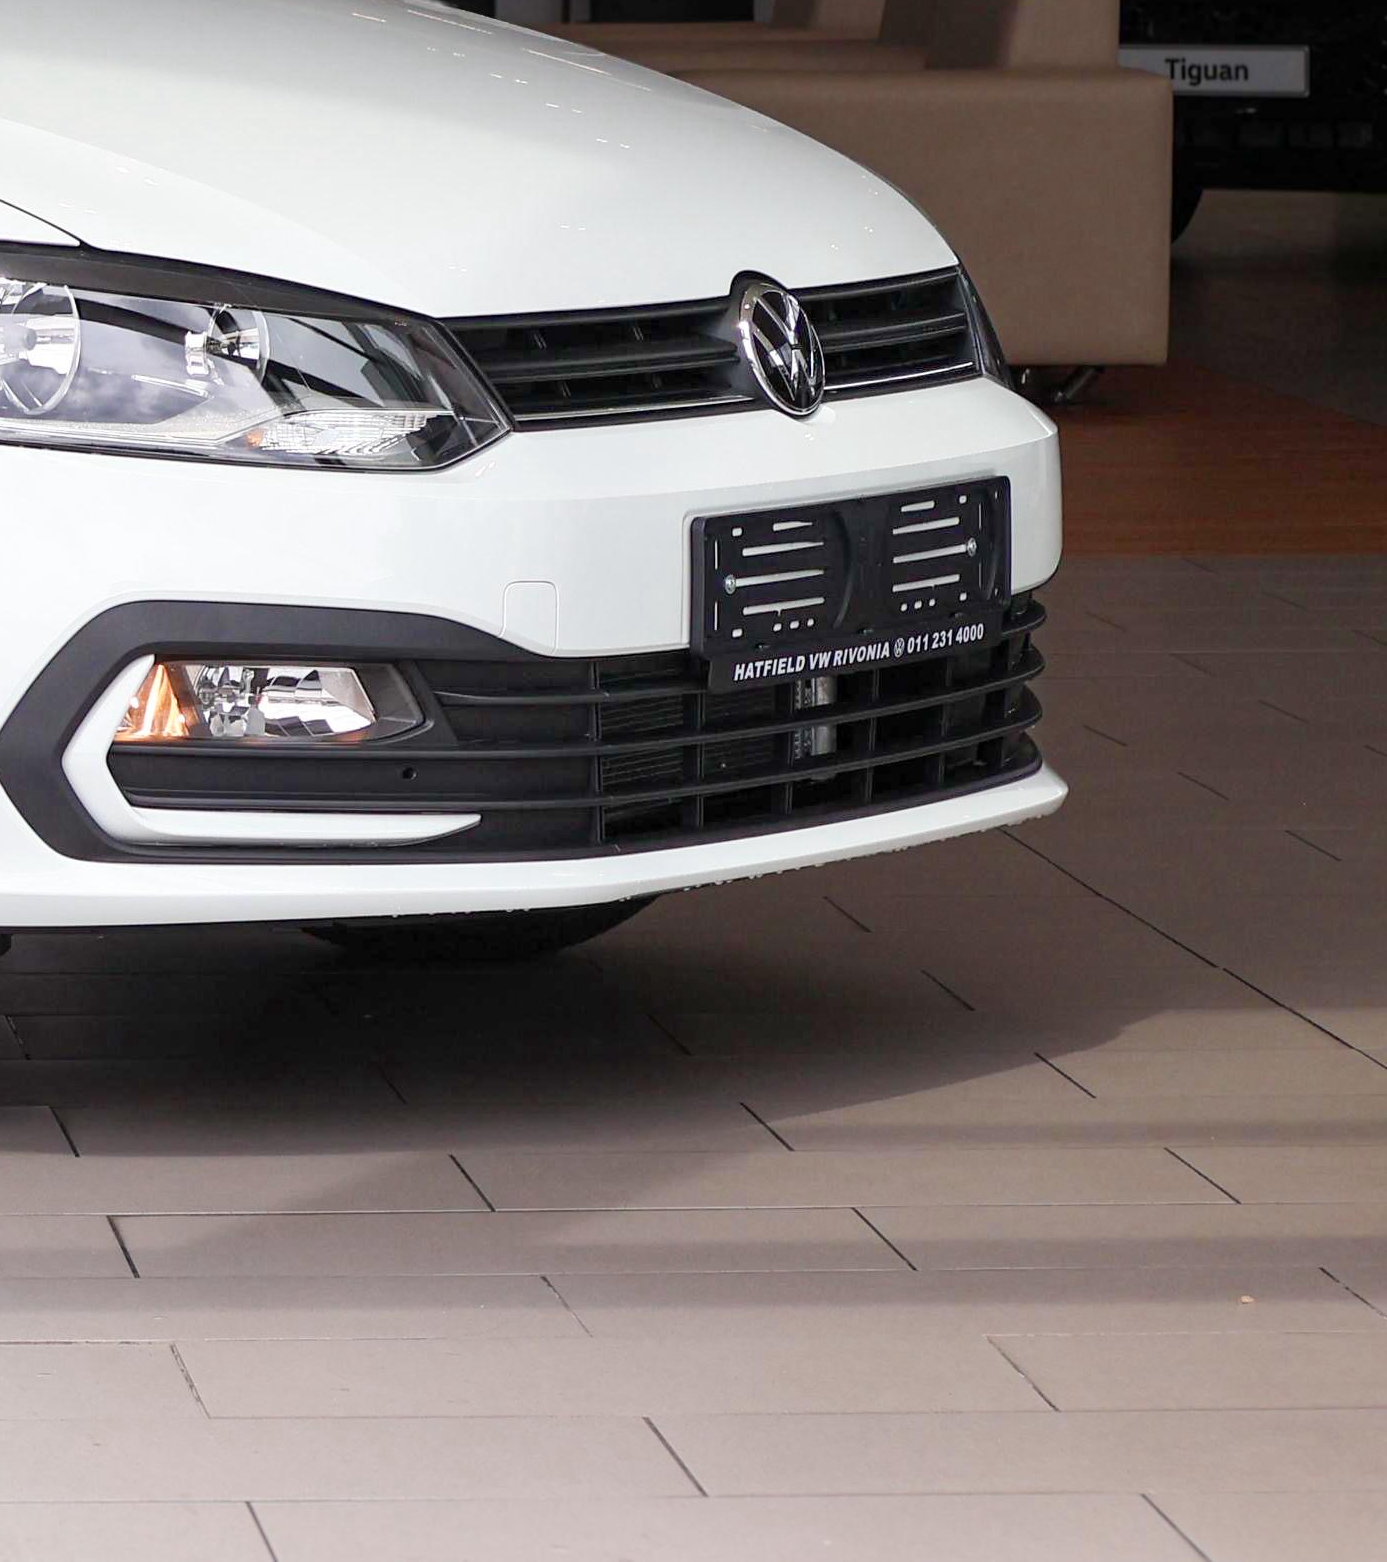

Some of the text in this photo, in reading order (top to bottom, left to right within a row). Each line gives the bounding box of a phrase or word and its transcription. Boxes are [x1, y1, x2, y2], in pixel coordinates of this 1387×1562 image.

[1165, 58, 1250, 86] Tiguan
[733, 655, 806, 681] HATFIELD
[809, 652, 831, 670] VW
[833, 641, 891, 667] RIVONIA
[907, 634, 929, 654] 011
[931, 629, 954, 650] 231
[955, 623, 984, 645] 4000
